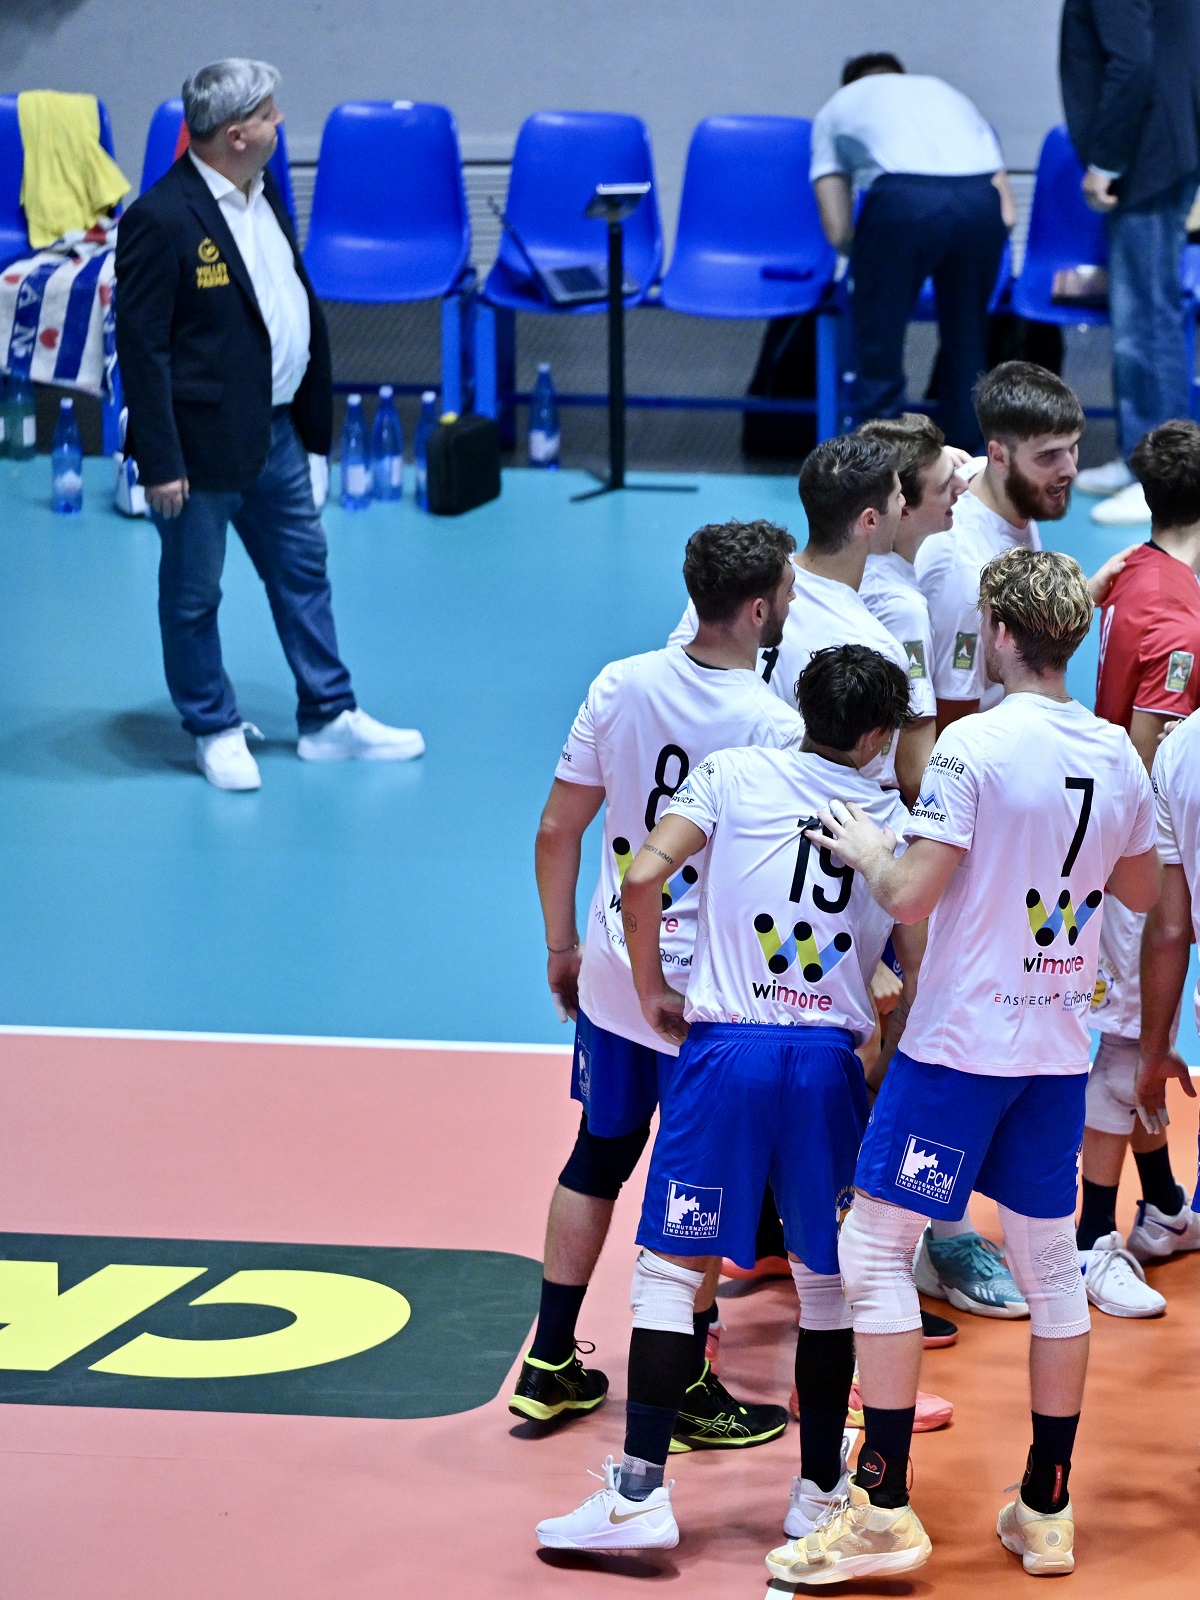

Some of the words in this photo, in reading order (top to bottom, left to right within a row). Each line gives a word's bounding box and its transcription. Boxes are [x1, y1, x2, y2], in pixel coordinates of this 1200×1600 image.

[644, 743, 690, 833] 8
[1061, 777, 1095, 878] 7
[1023, 952, 1085, 975] wimore
[752, 979, 833, 1012] wimore
[994, 993, 1052, 1006] EASYTECH
[898, 1179, 947, 1200] INDUSTRIALI
[900, 1174, 949, 1196] MANUTENZIONI
[926, 1168, 953, 1191] PCM
[667, 1222, 716, 1231] MANUTENZIONI
[692, 1211, 717, 1227] PCM
[666, 1227, 715, 1237] INDUSTRIALI
